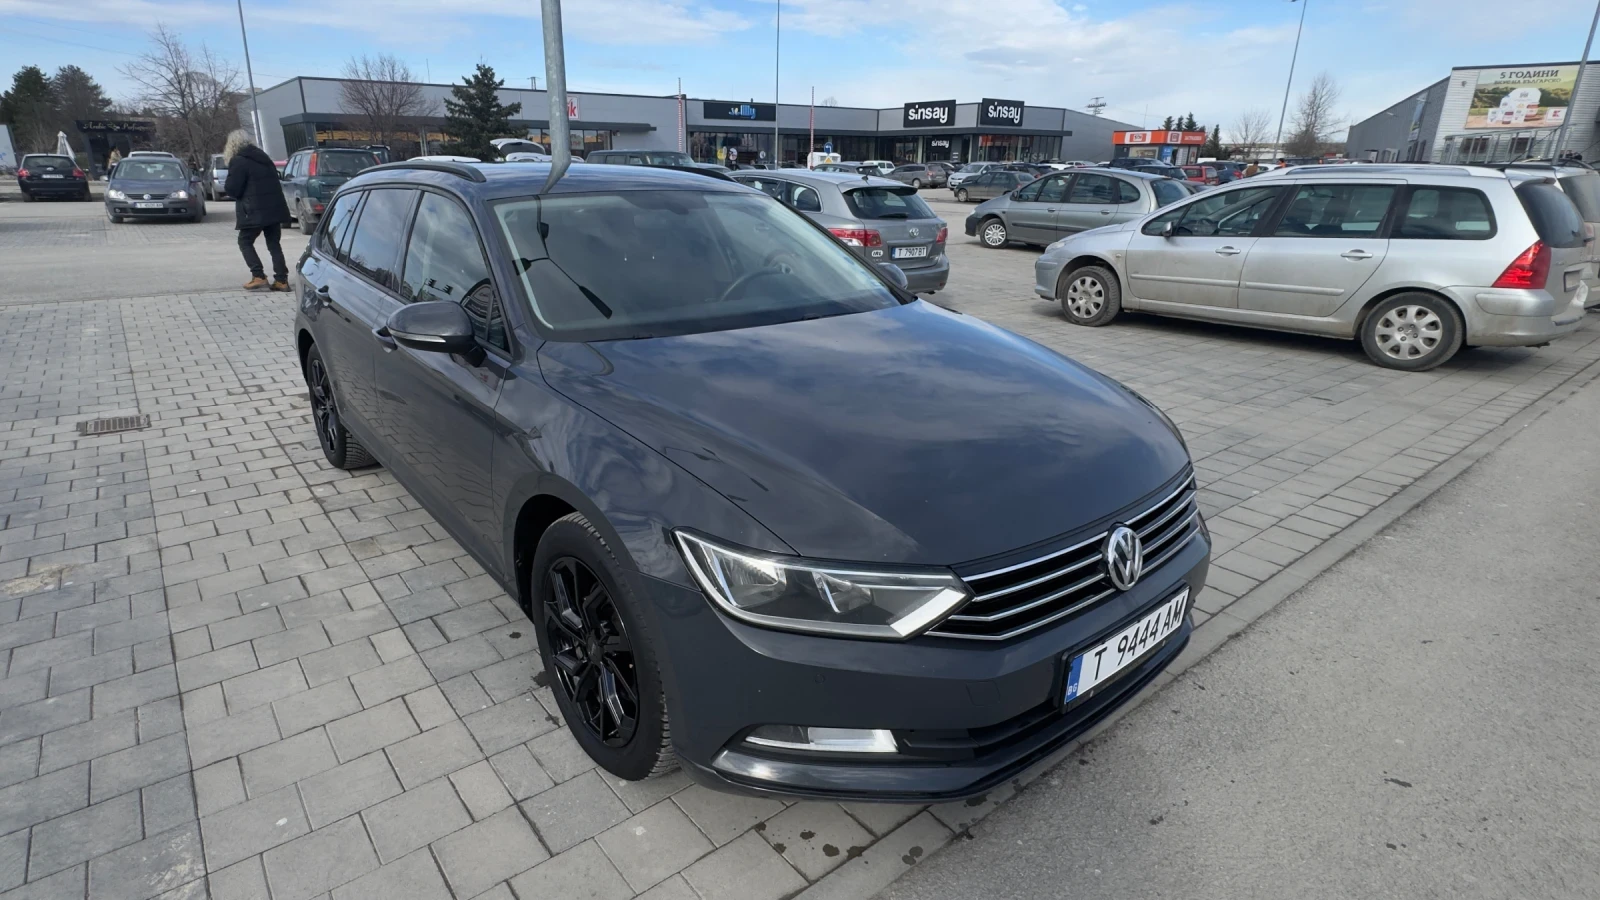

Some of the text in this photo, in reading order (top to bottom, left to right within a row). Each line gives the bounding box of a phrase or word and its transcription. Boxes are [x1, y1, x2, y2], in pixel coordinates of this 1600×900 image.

[1508, 70, 1560, 79] ГОДИНИ
[908, 104, 949, 124] sinsay
[987, 101, 1021, 124] sinsay
[931, 139, 950, 148] sinsay
[1094, 595, 1185, 681] T 9444 AM
[1067, 682, 1078, 696] BG
